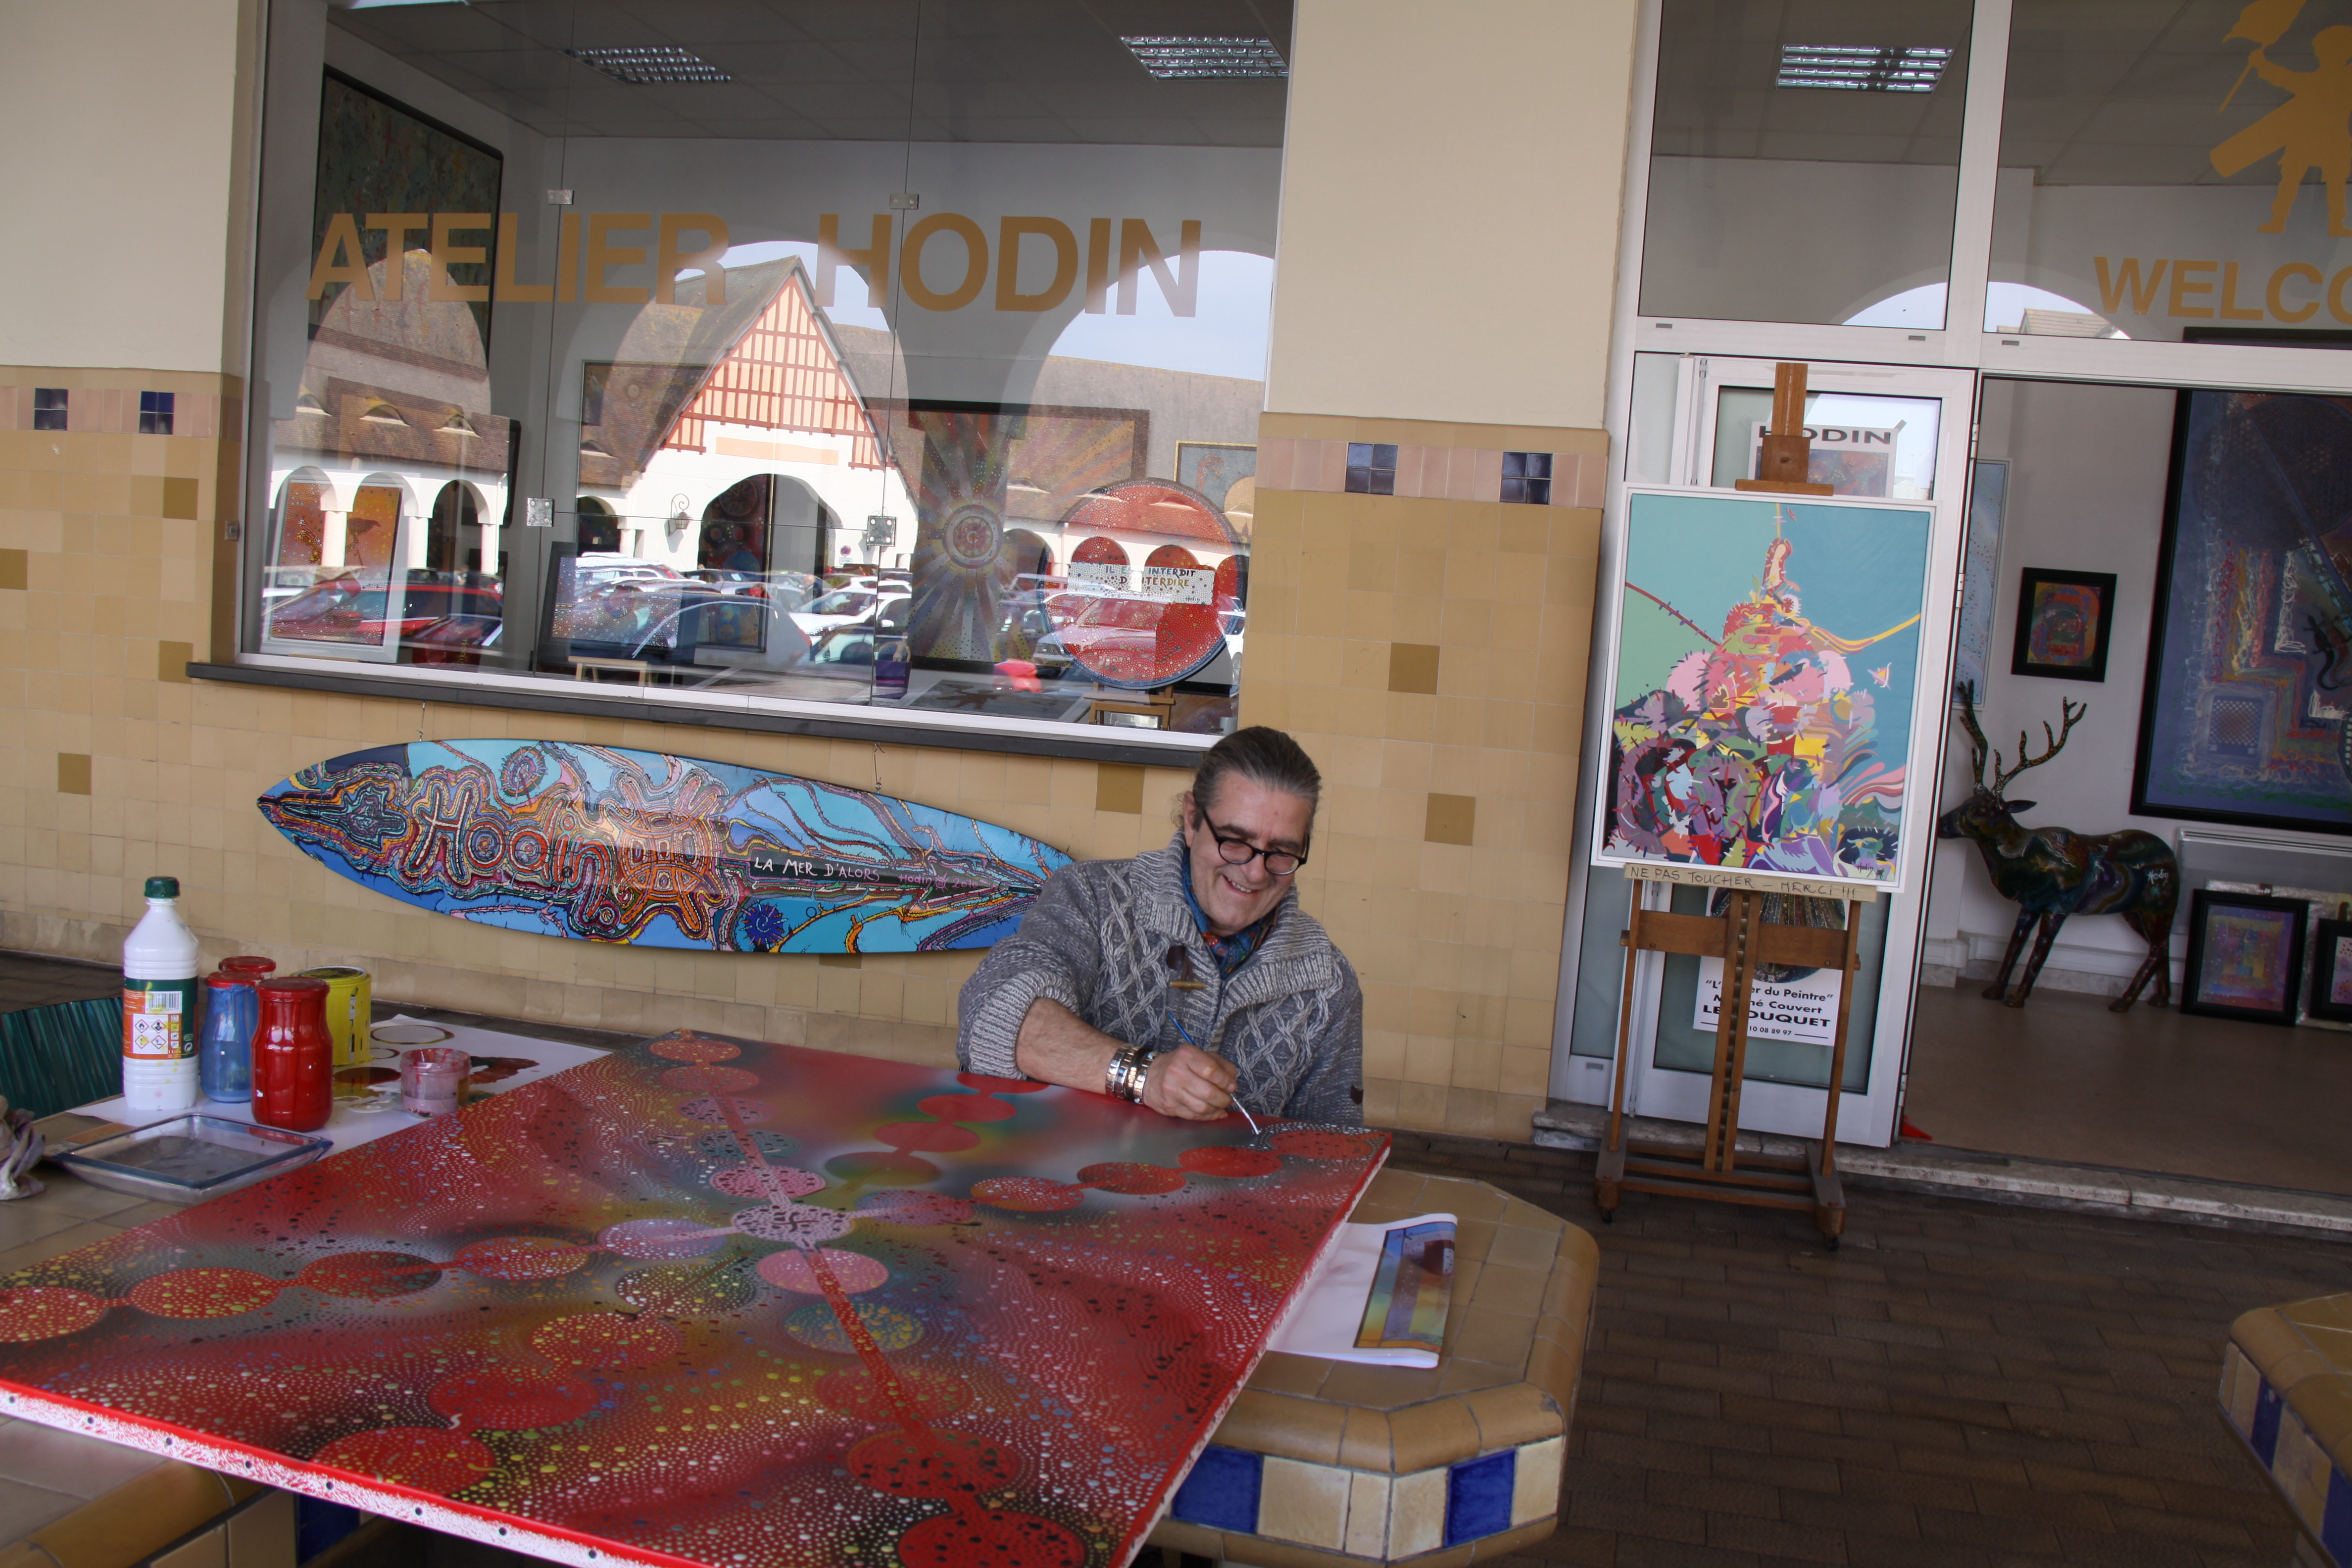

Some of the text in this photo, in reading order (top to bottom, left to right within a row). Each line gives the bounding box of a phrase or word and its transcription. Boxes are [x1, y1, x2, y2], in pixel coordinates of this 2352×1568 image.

[305, 213, 1201, 317] ATELIER HODIN
[1148, 567, 1196, 579] INTERDIT
[1119, 576, 1189, 589] DTERDIRE
[754, 857, 880, 882] LA MER D'ALORS
[1631, 867, 1649, 878] NE
[1655, 869, 1680, 880] PAS
[1688, 872, 1756, 888] TOUCHER
[898, 874, 979, 890] Hodin 2010
[1764, 986, 1779, 996] du
[1769, 1001, 1822, 1014] Couvert
[1703, 1005, 1830, 1027] LE OUQUET
